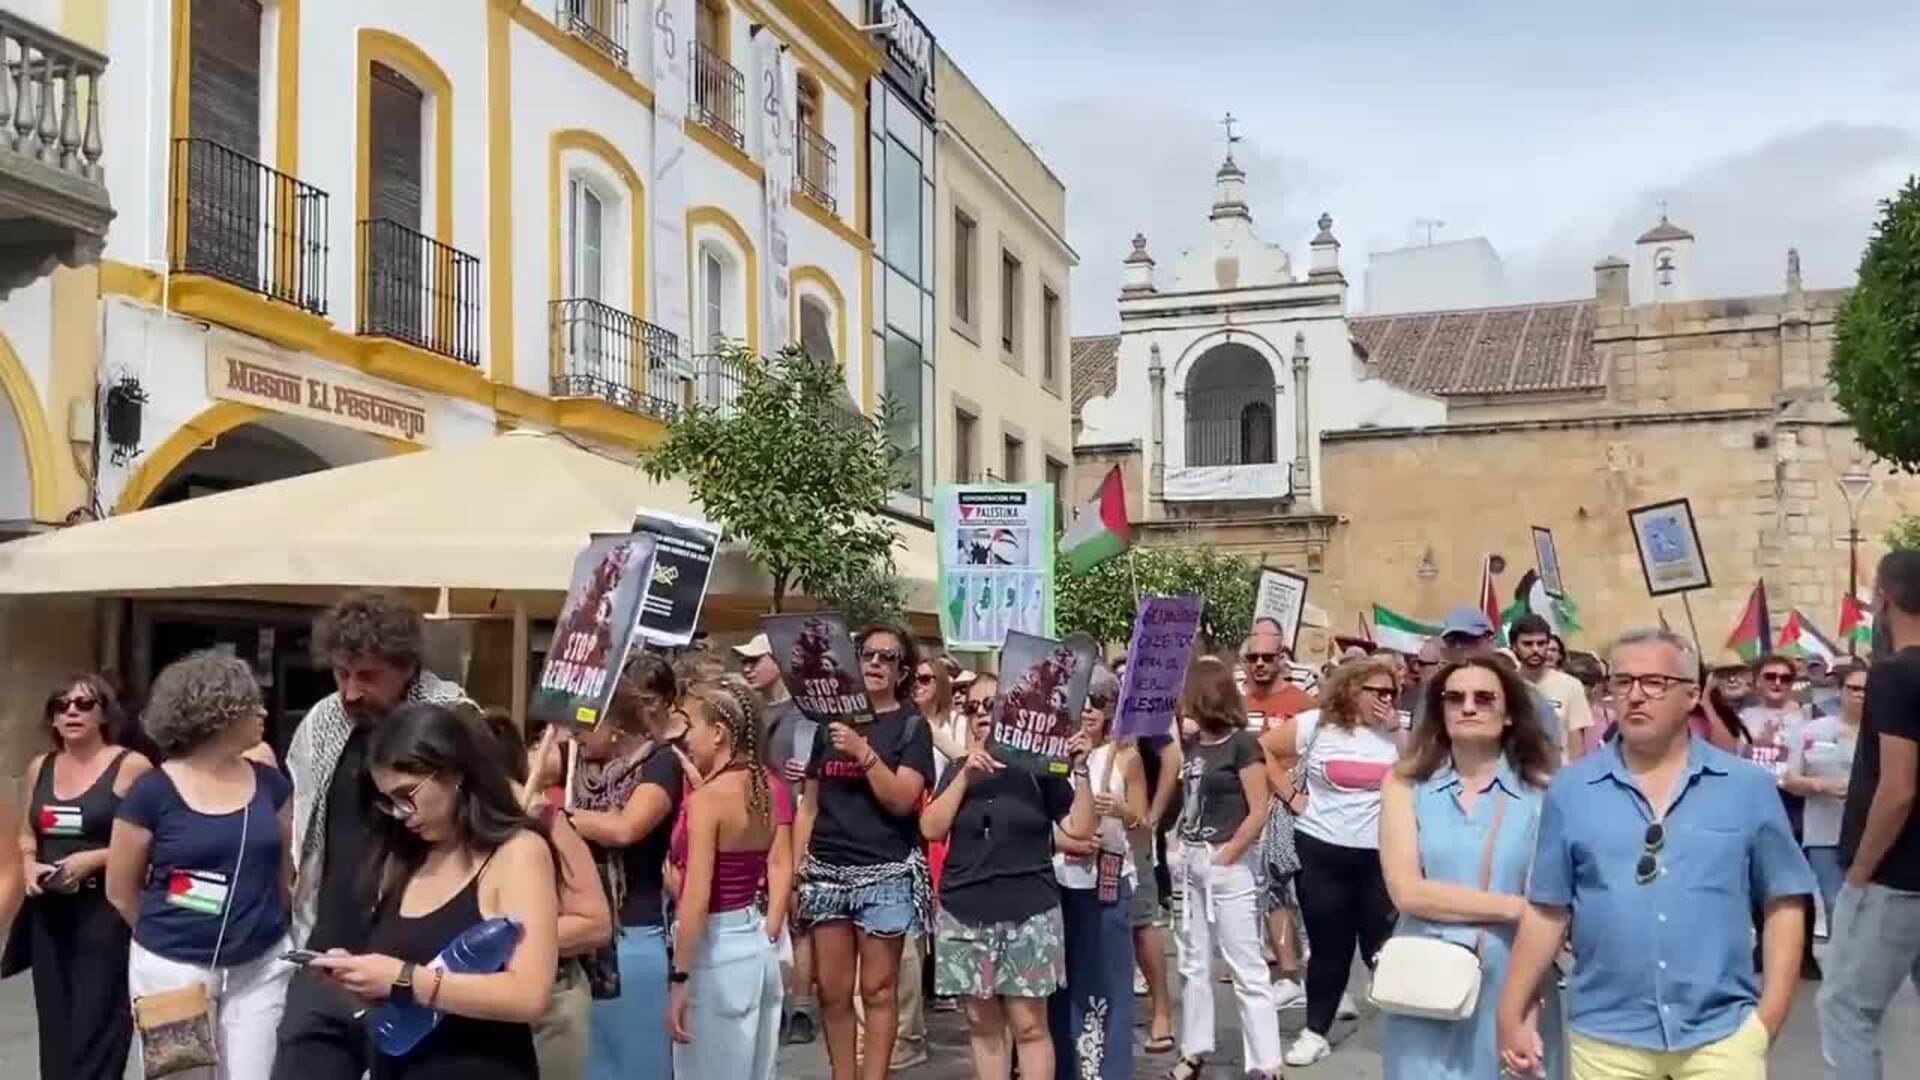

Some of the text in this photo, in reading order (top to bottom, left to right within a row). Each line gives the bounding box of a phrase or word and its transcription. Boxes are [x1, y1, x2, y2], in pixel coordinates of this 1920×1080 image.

[307, 378, 332, 412] El
[976, 506, 1018, 518] PALESTINA
[564, 631, 598, 661] STOP
[804, 677, 839, 697] STOP
[795, 692, 867, 715] GENOCIDIO
[1017, 708, 1057, 734] STOP
